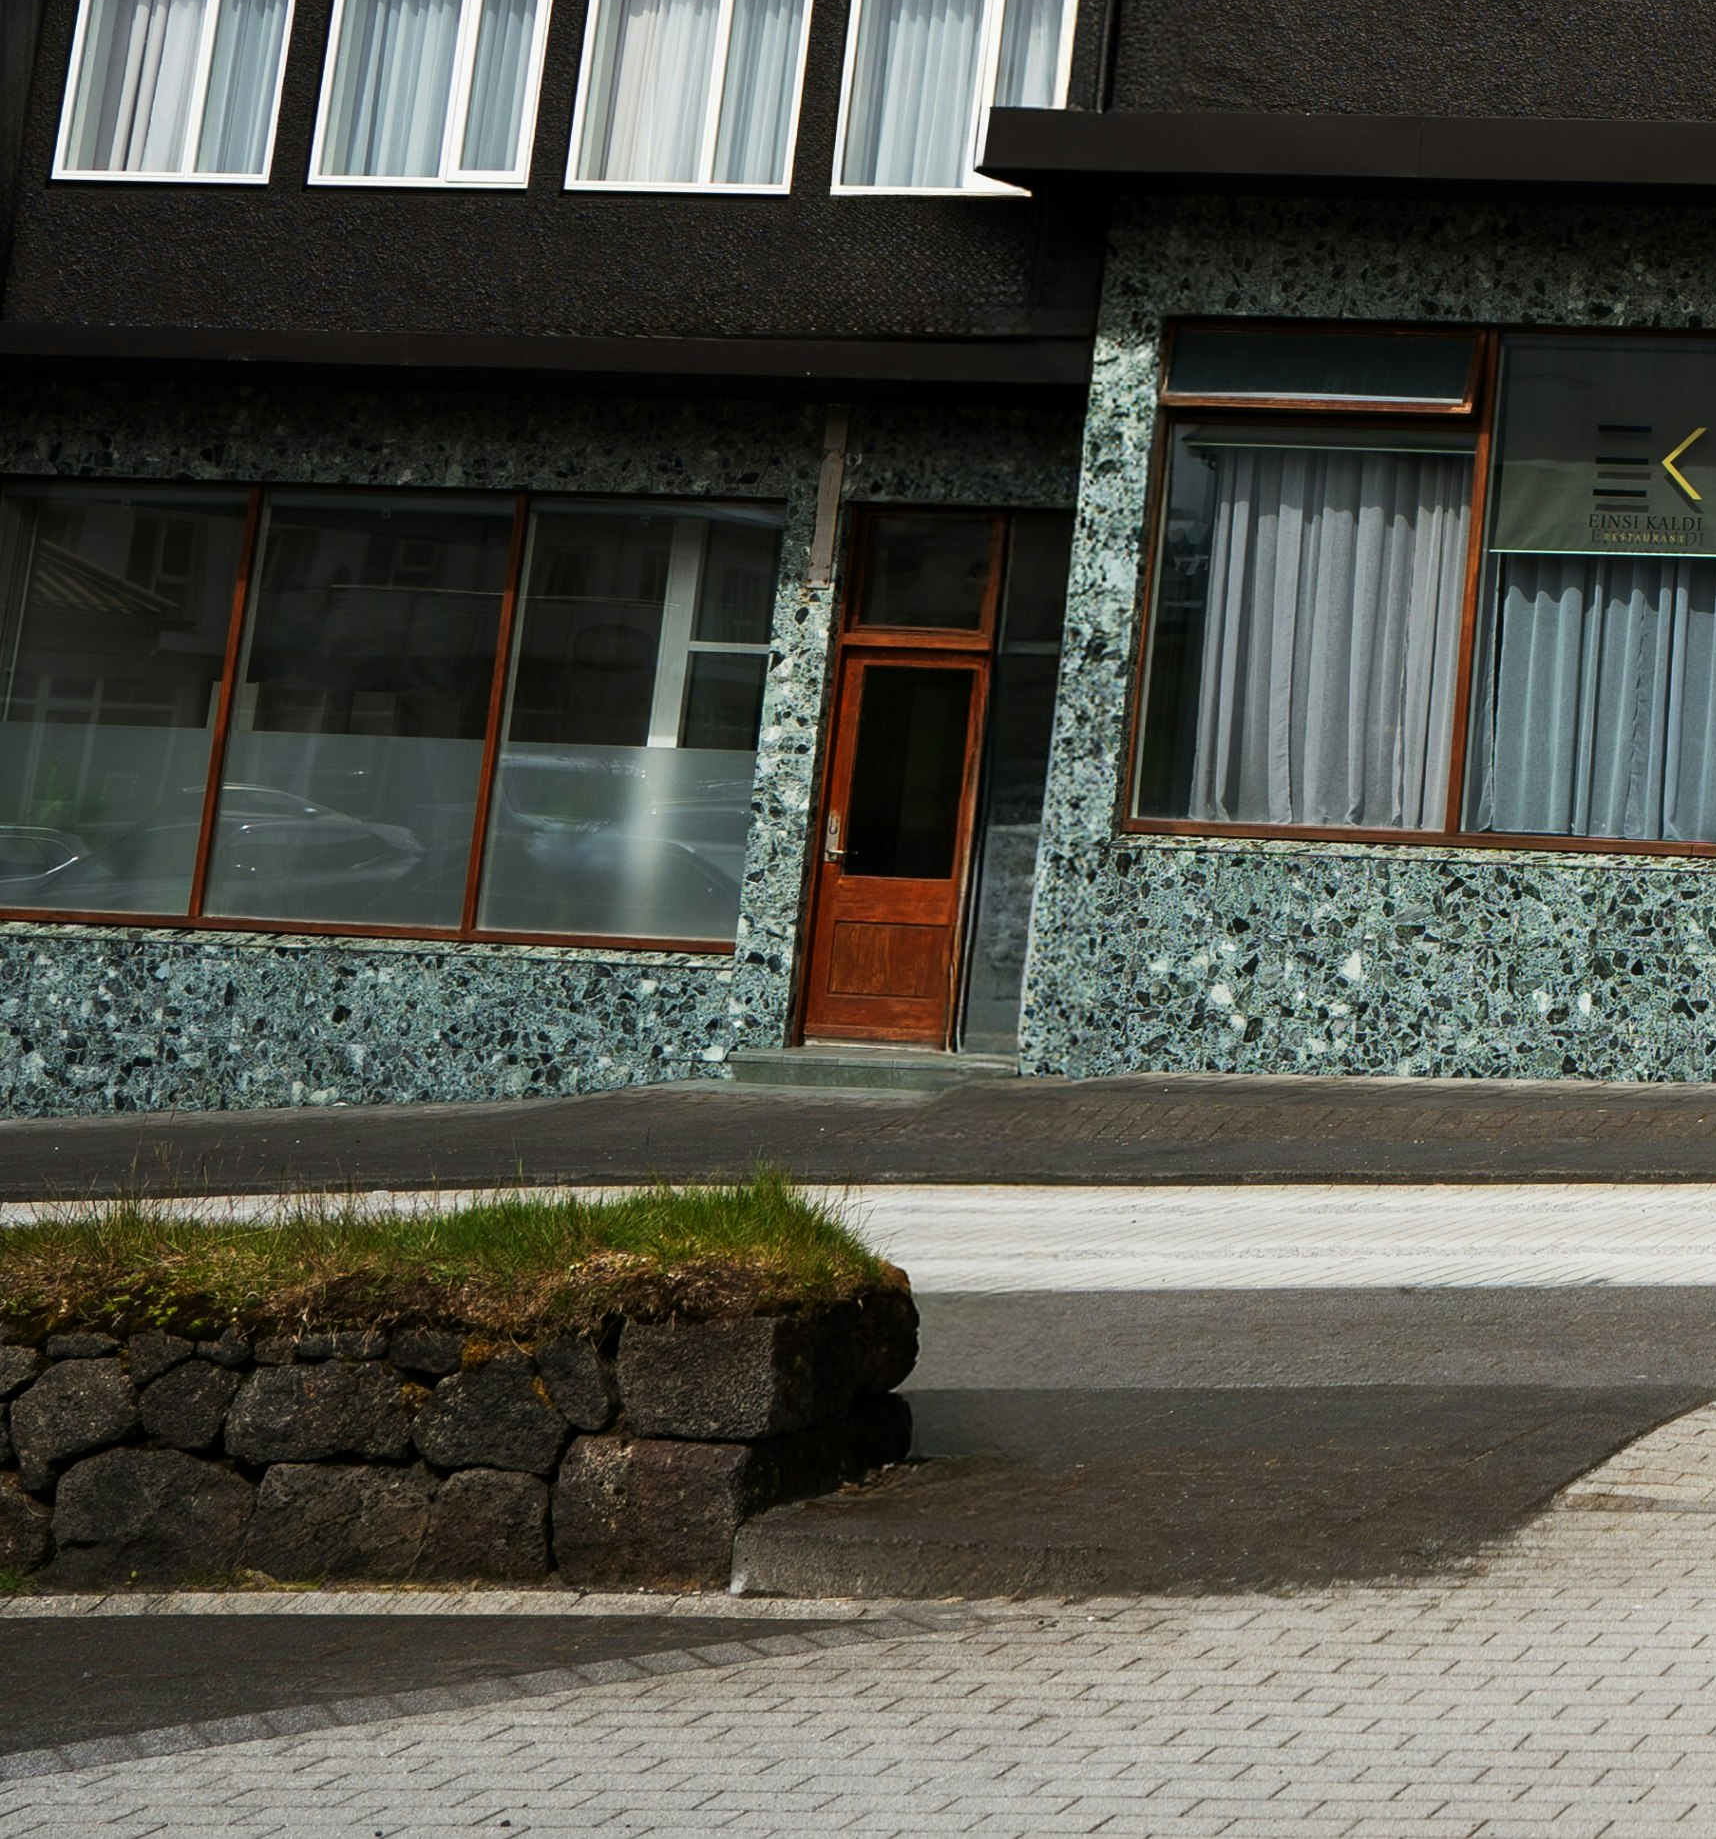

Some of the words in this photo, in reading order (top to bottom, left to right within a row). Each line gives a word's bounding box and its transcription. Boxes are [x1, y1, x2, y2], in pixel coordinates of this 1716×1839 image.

[1588, 513, 1639, 530] EINSI
[1646, 515, 1703, 532] KALDI
[1603, 532, 1685, 544] RESTAURANT
